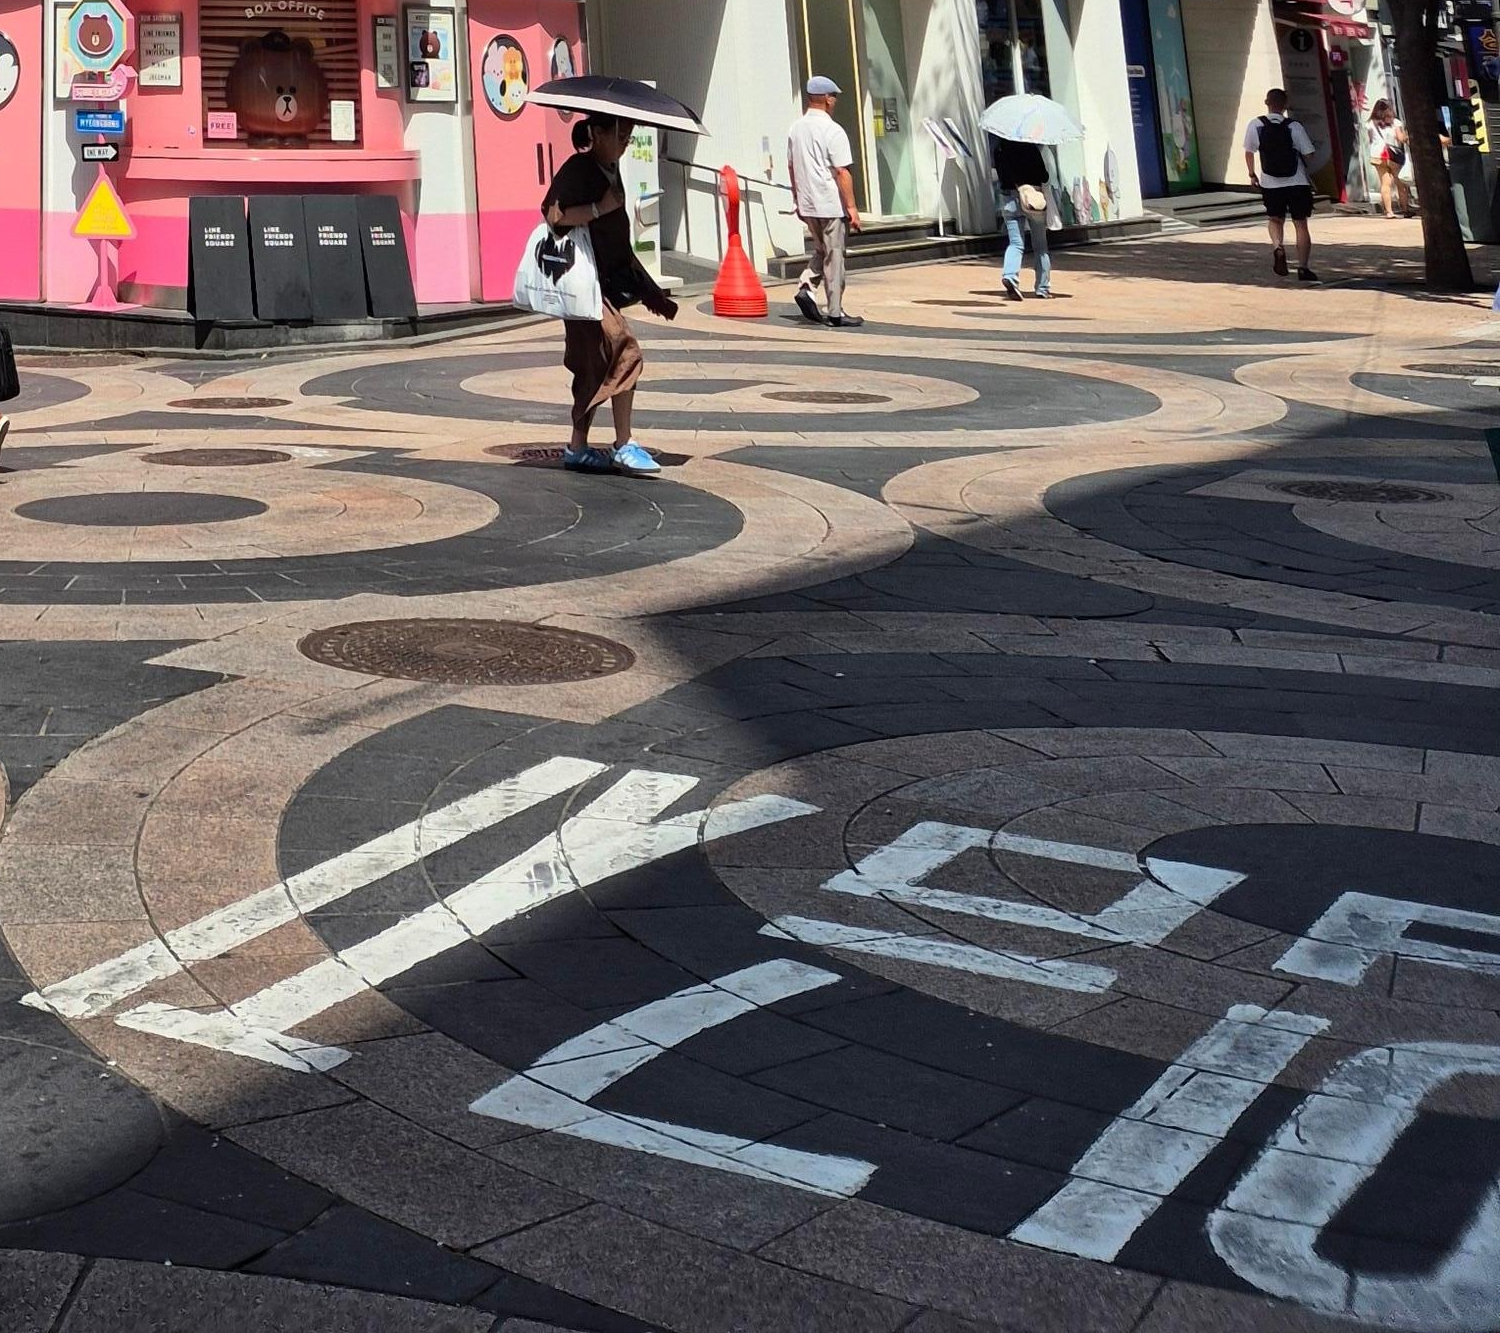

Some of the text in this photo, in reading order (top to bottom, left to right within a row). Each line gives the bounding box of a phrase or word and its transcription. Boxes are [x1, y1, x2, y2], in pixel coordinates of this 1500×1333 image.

[244, 0, 326, 21] BOX OFFICE
[86, 147, 109, 157] ONE WAY
